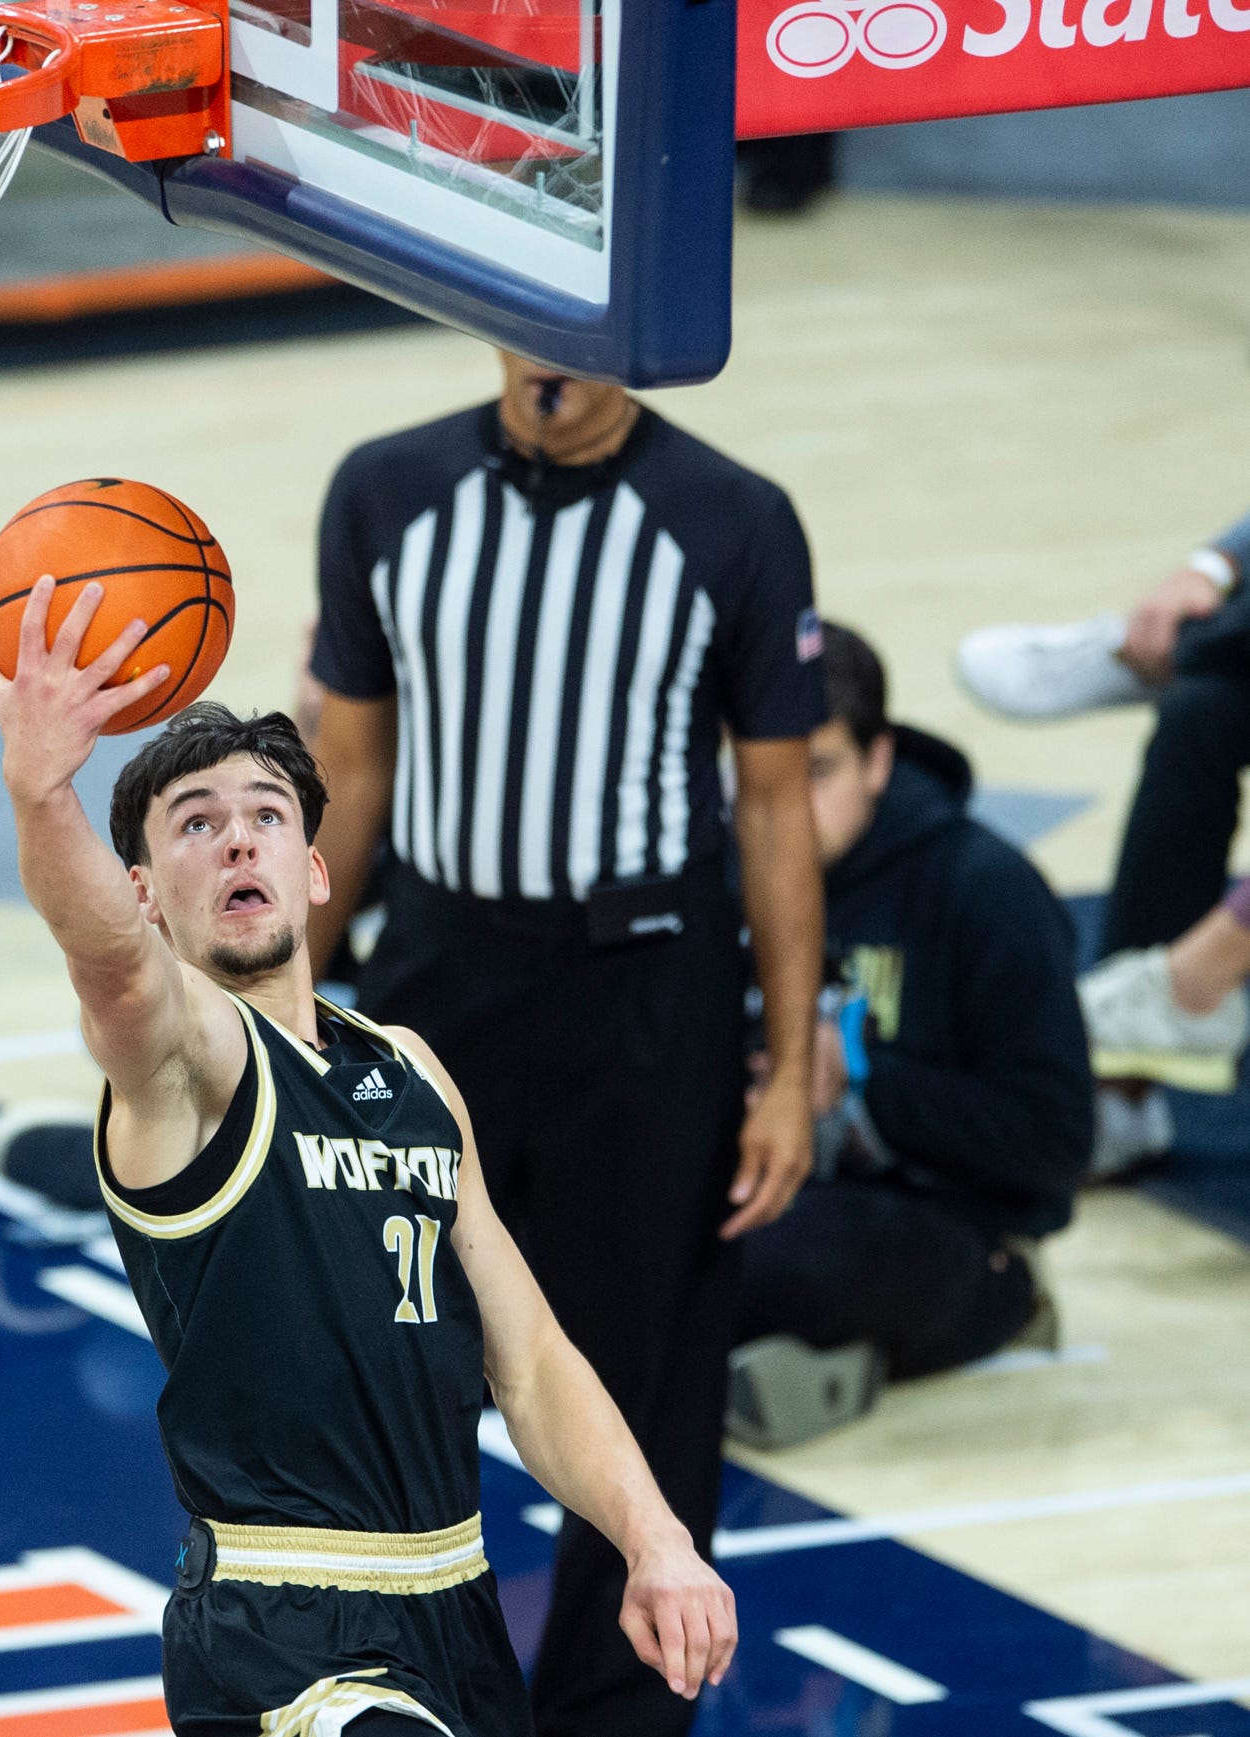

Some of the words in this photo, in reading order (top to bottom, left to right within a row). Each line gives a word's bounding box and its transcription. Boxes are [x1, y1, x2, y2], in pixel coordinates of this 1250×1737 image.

[352, 1087, 393, 1101] adidas
[292, 1131, 462, 1200] WOFO
[383, 1214, 440, 1324] 21
